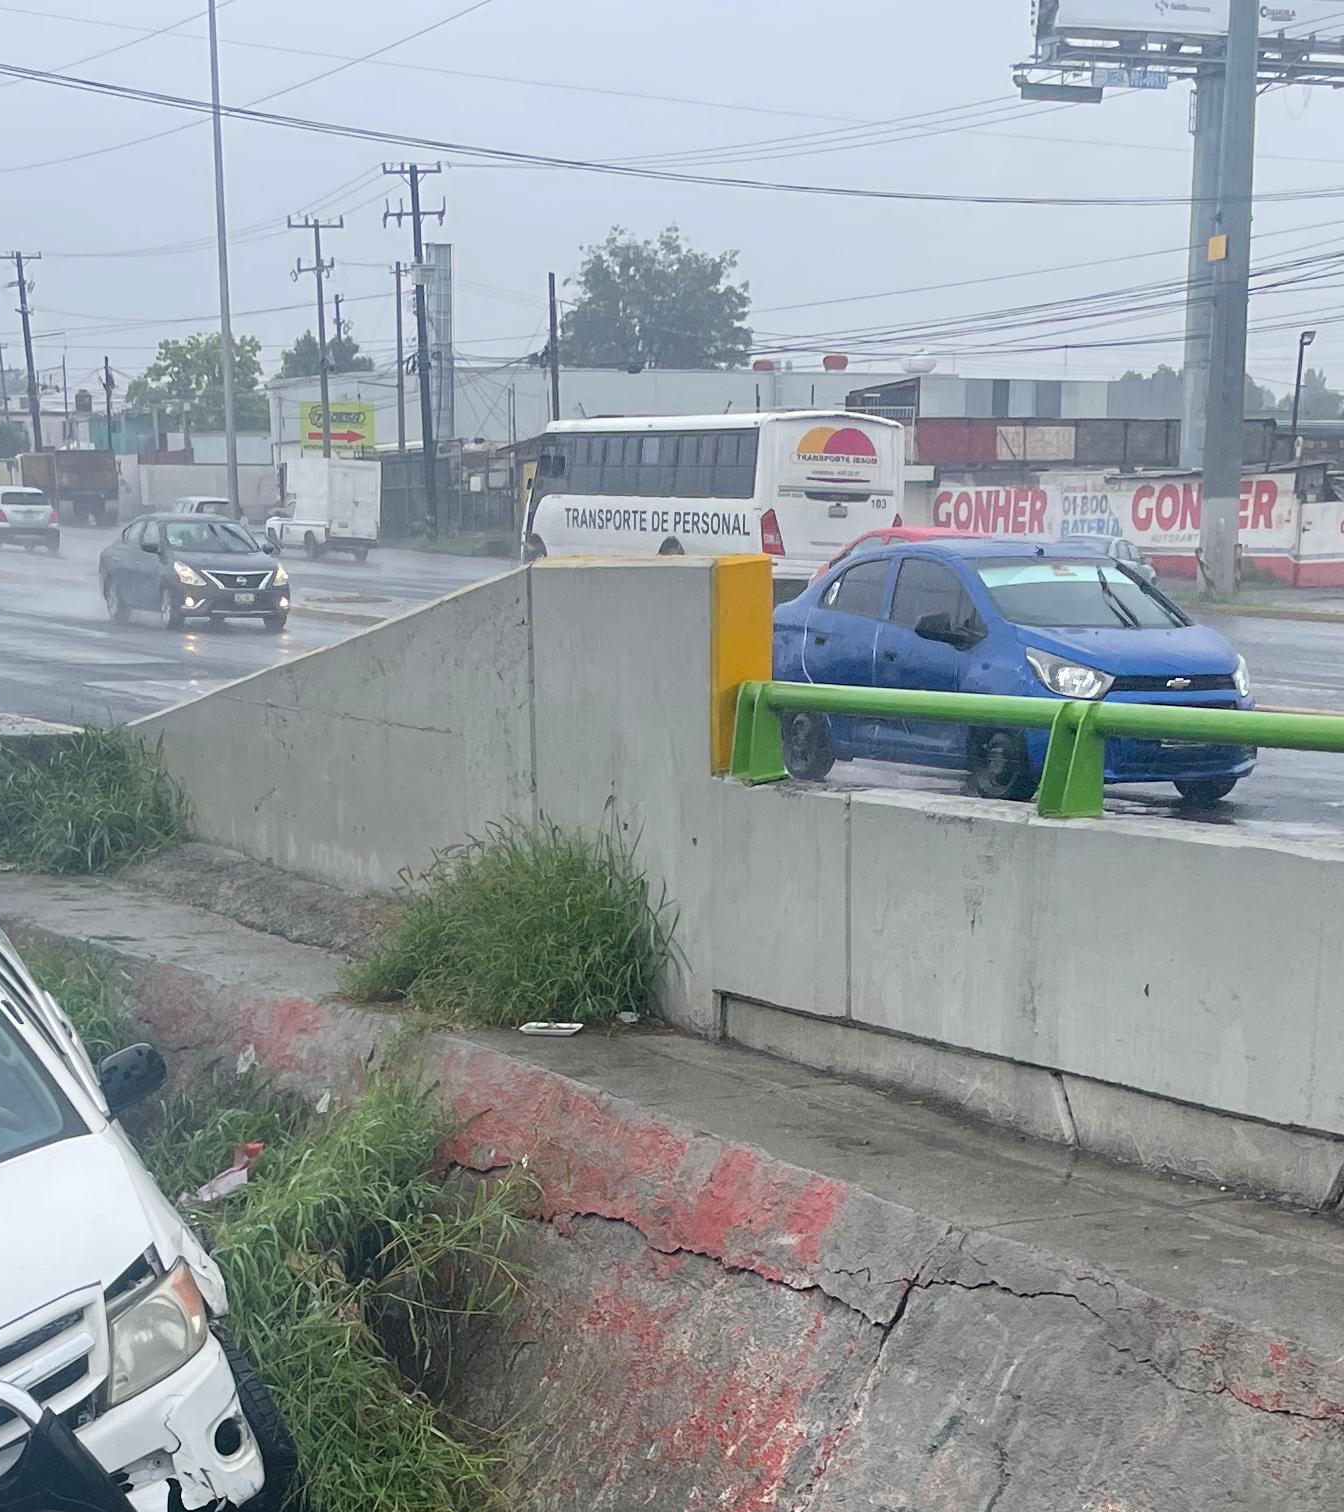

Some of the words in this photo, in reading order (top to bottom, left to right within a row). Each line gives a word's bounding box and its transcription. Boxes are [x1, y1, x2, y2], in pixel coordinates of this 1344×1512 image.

[564, 507, 647, 532] TRANSPORTE
[651, 510, 669, 533] DE
[673, 511, 751, 536] PERSONAL
[871, 499, 887, 509] 103
[932, 488, 1048, 535] GONHER
[1131, 479, 1279, 532] GONER
